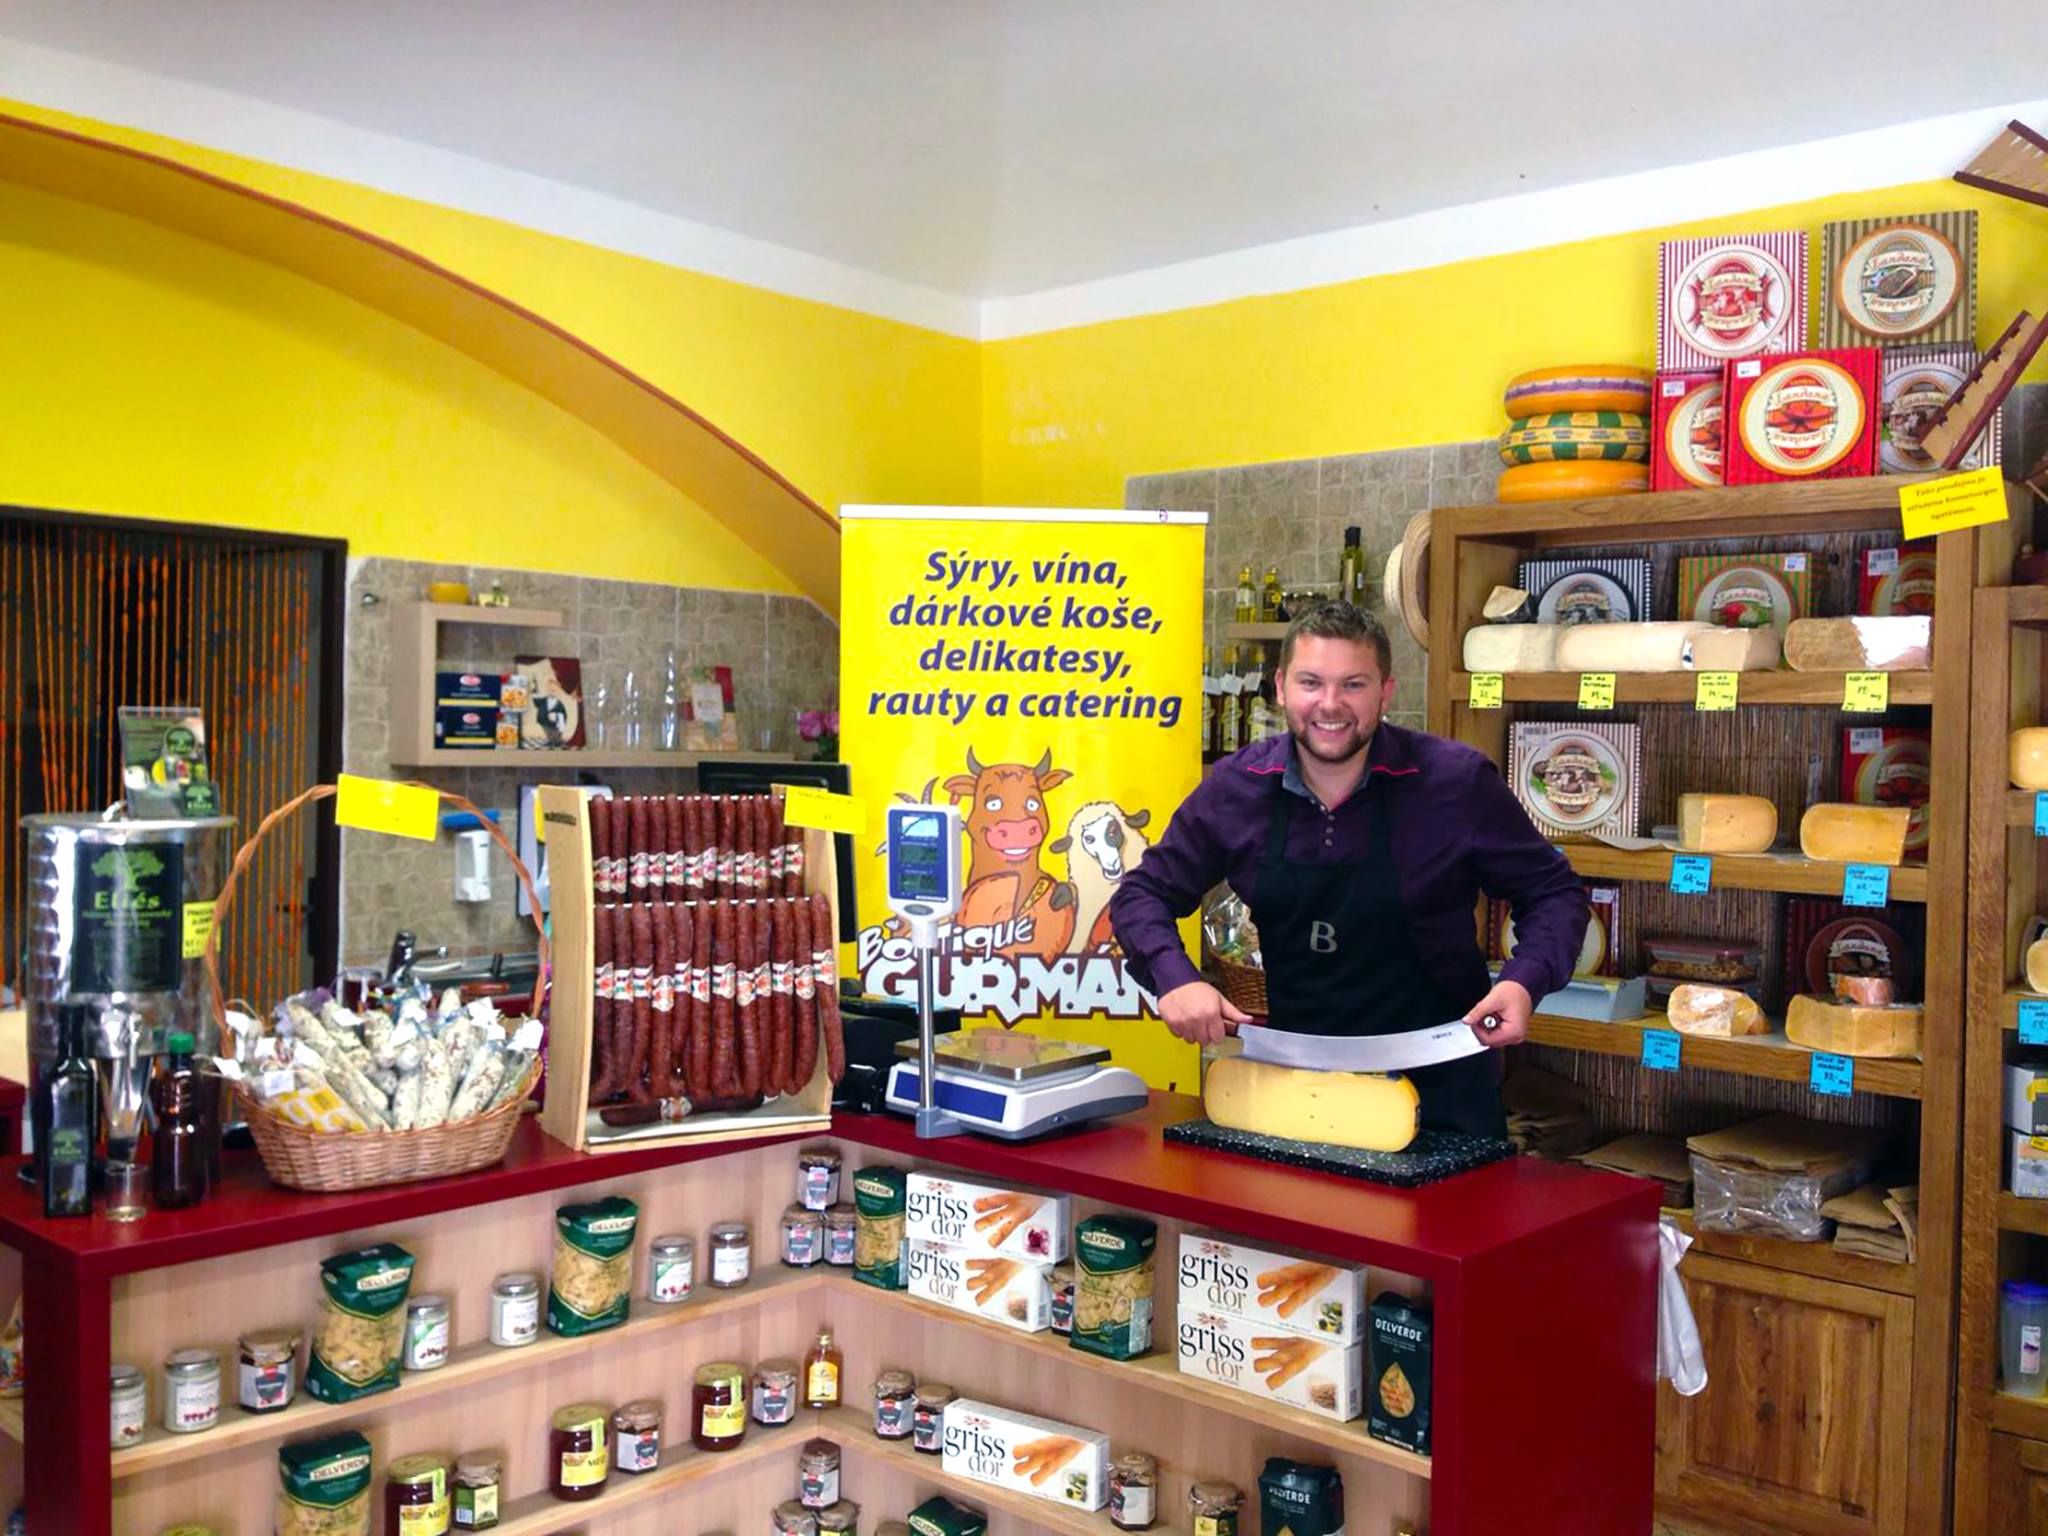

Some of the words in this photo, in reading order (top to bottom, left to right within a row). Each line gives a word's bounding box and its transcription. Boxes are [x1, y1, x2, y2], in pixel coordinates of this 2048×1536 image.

[925, 550, 1020, 590] Sýry,
[1033, 551, 1128, 590] vína,
[889, 594, 1052, 629] dárkové
[1062, 597, 1164, 634] koše,
[919, 638, 1132, 683] delikatesy,
[868, 687, 977, 725] rauty
[985, 693, 1009, 716] a
[1019, 686, 1183, 728] catering
[1310, 920, 1338, 954] B
[907, 1190, 968, 1223] griss
[908, 1249, 960, 1282] griss
[1180, 1252, 1248, 1290] griss
[1179, 1322, 1245, 1363] griss
[1375, 1317, 1423, 1342] DELVERDE
[944, 1425, 1006, 1461] griss
